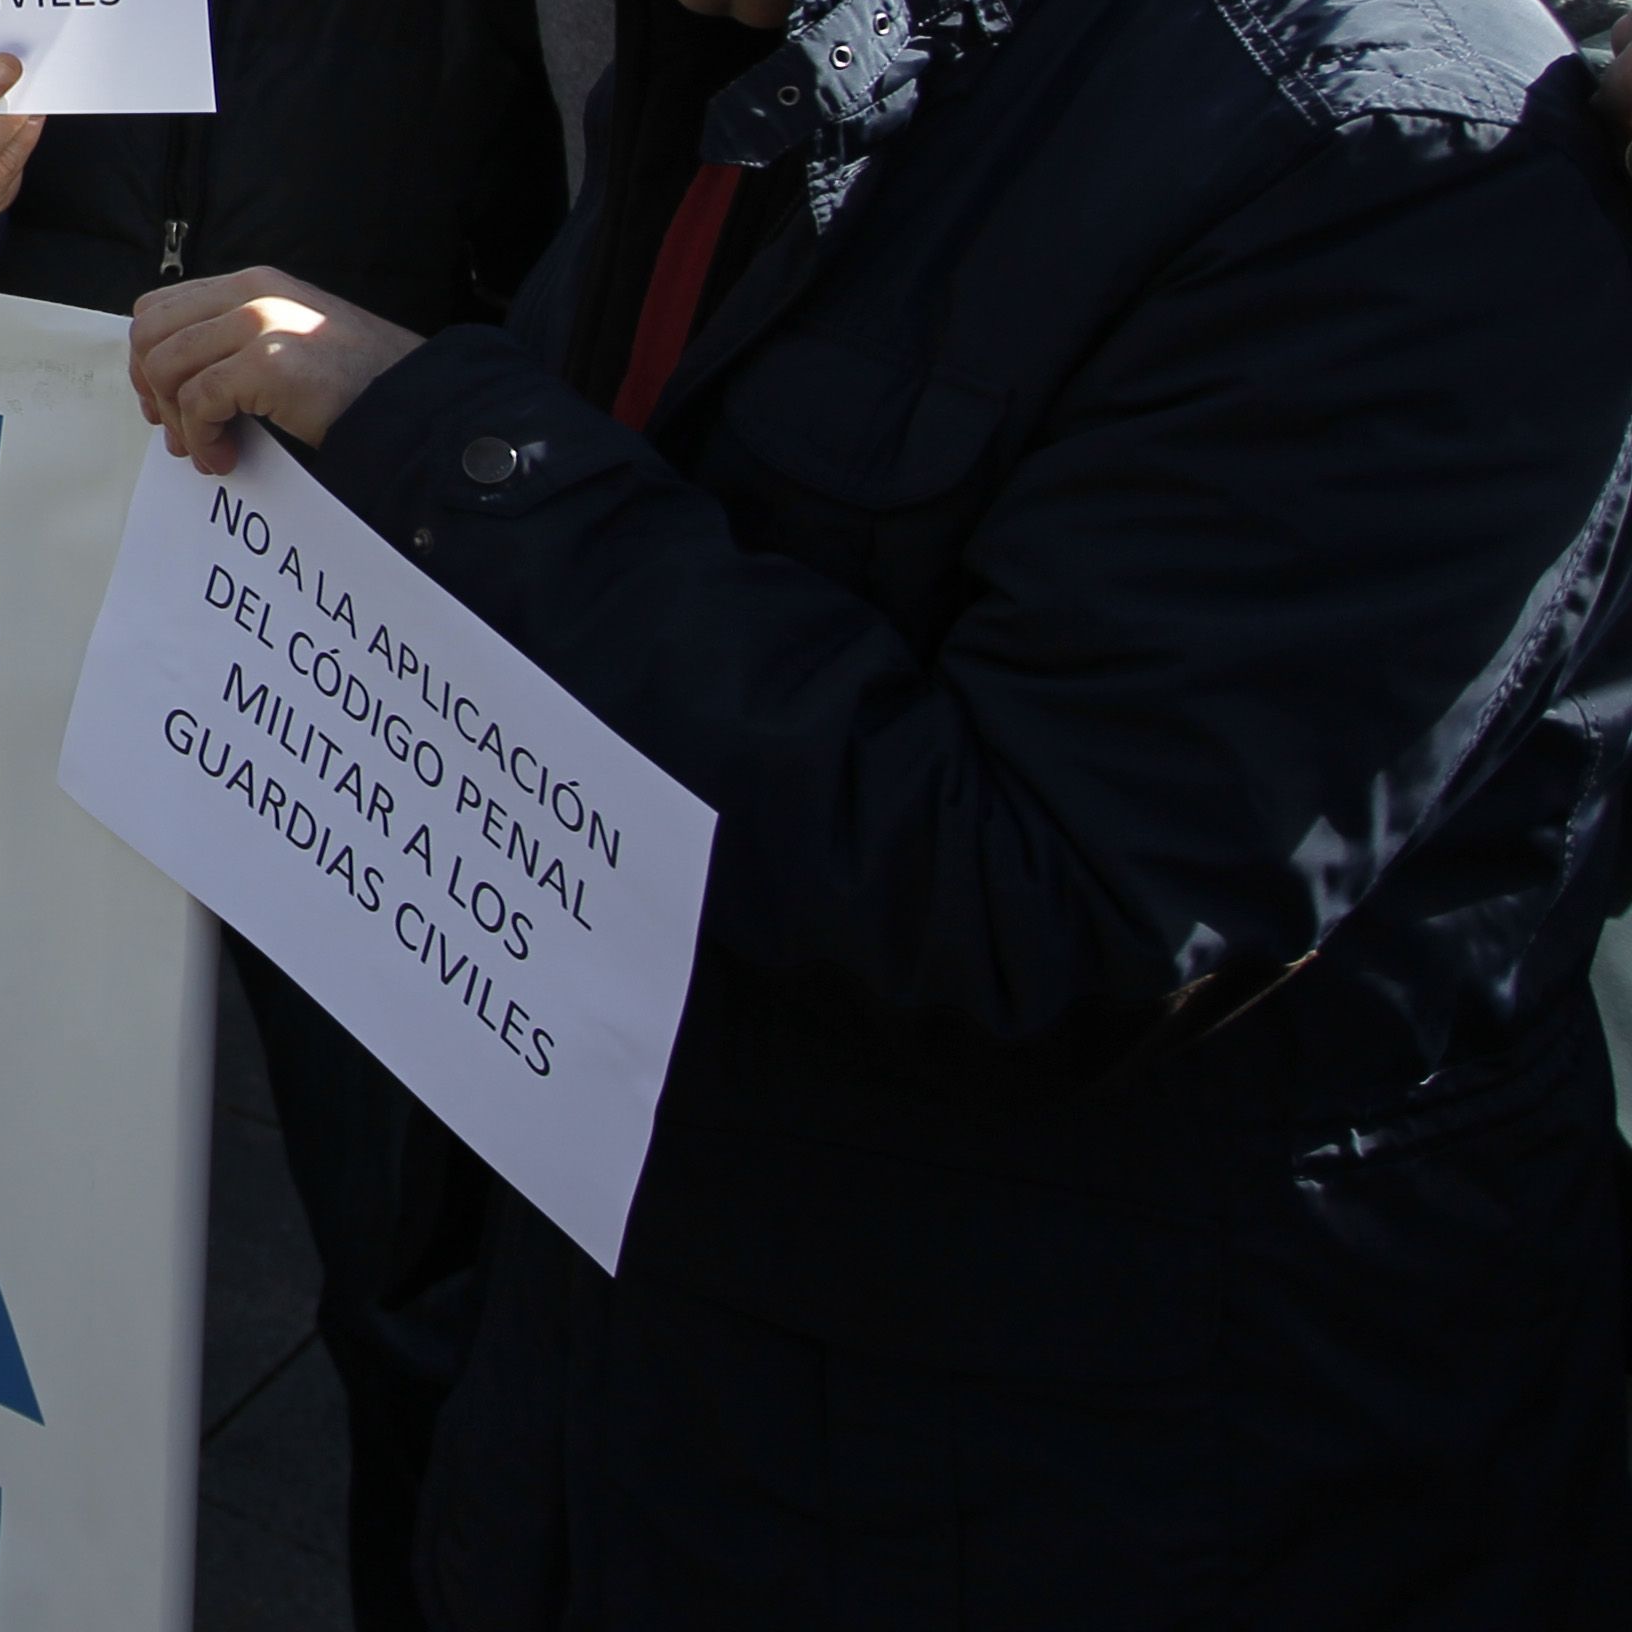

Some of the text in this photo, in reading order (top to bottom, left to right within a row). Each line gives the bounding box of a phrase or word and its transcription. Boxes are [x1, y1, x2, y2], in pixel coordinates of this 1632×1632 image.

[204, 563, 594, 931] DEL CÓDIGO PENAL
[209, 484, 621, 869] NO A LA APLICACIÓN
[221, 663, 535, 962] MILITAR A LOS
[164, 709, 556, 1077] GUARDIAS CIVILES
